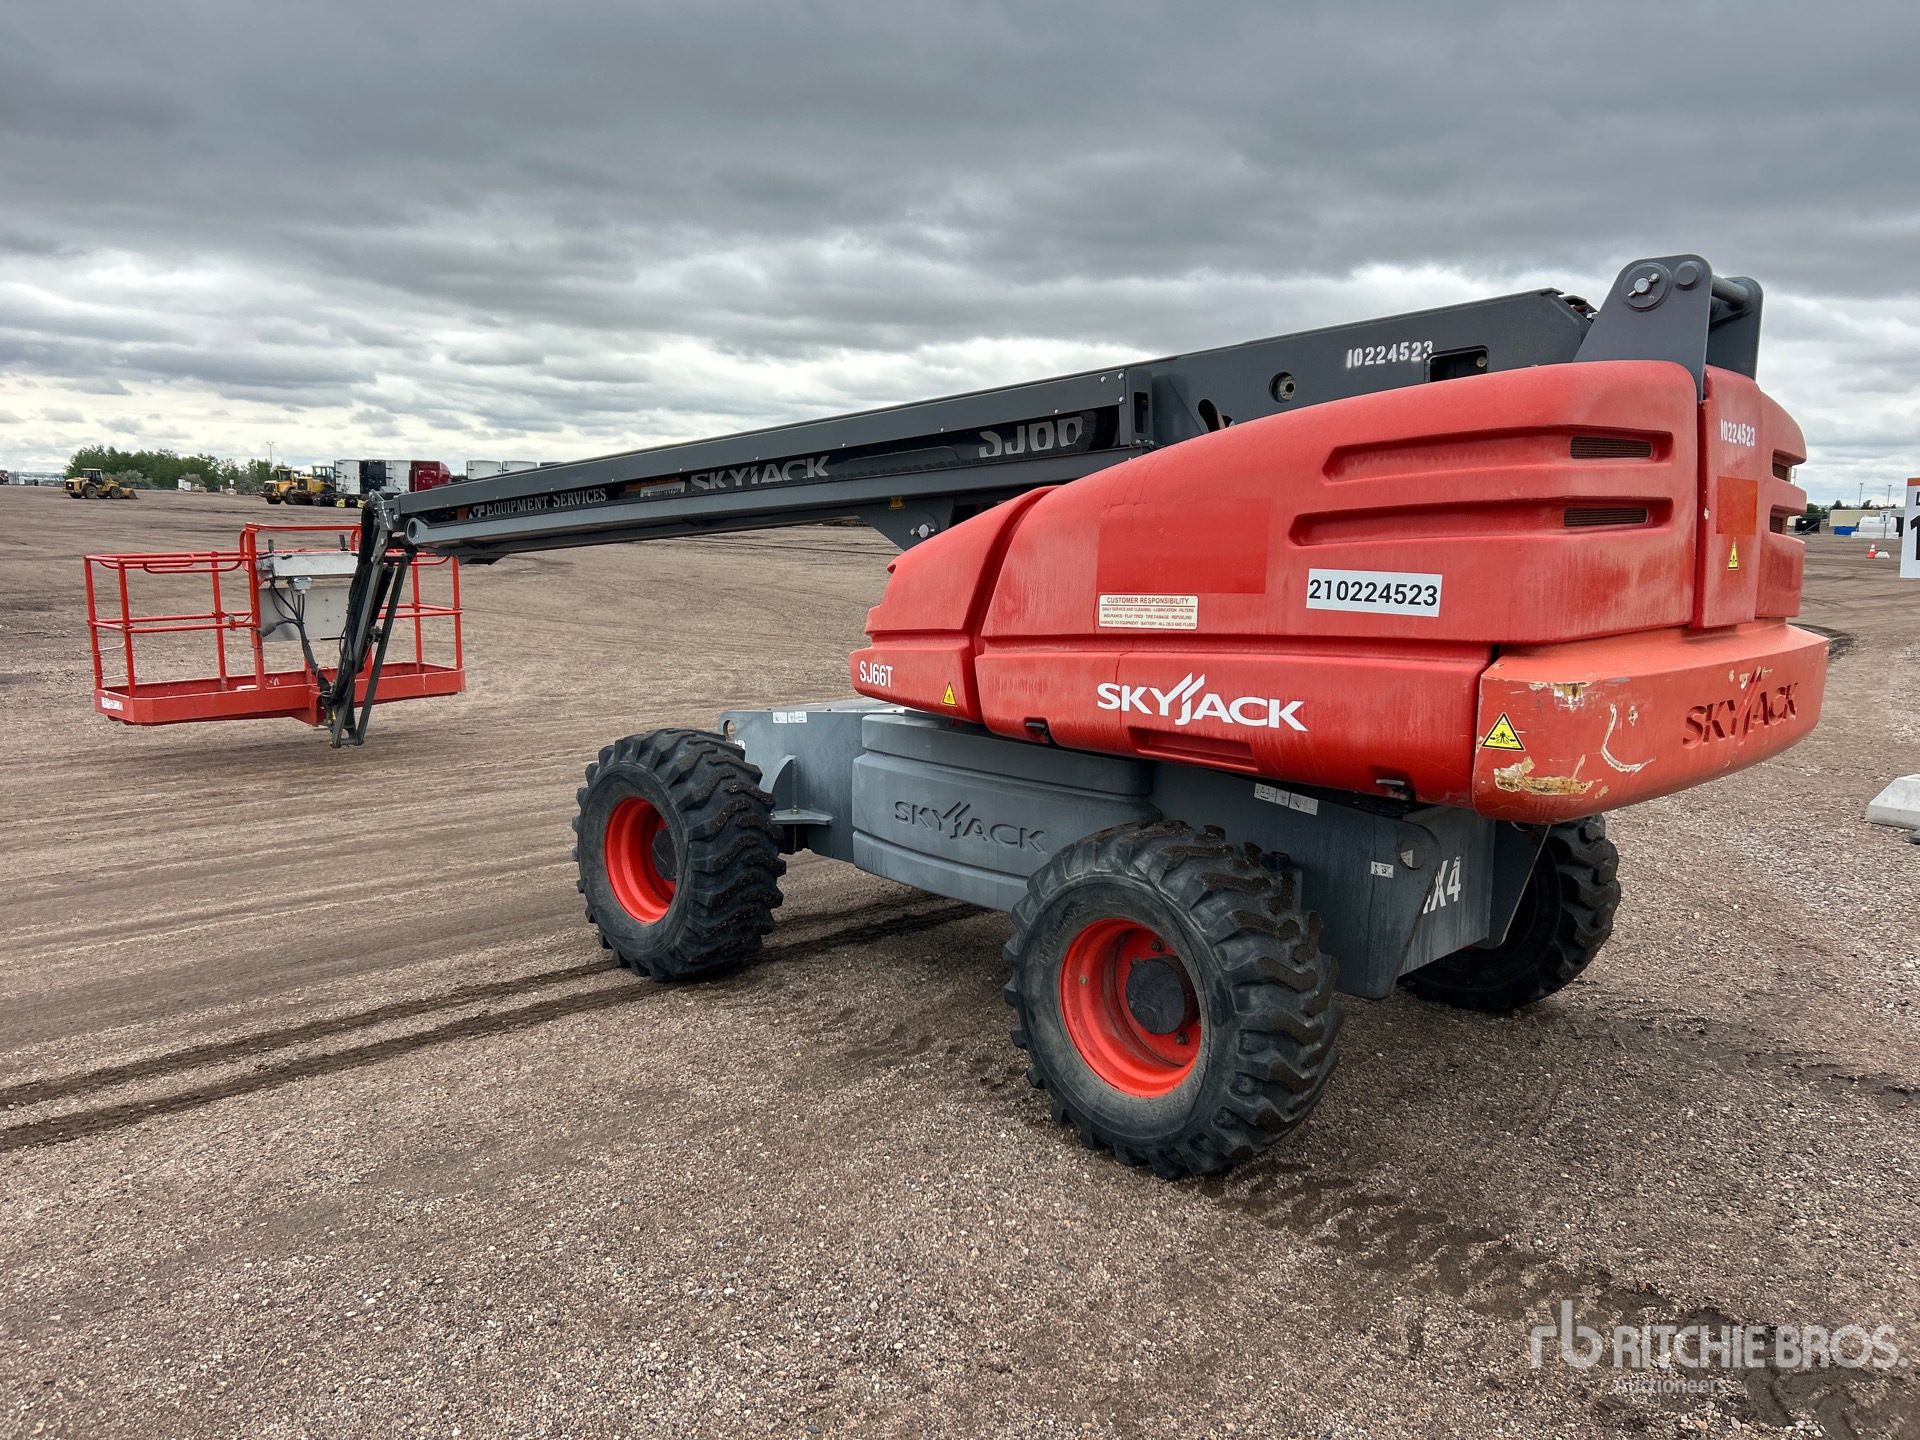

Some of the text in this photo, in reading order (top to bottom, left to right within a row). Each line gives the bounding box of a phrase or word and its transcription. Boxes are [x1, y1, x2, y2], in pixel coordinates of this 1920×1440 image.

[1346, 340, 1433, 369] 10224523
[1720, 419, 1756, 447] 10224523
[486, 496, 549, 516] EQUIPMENT
[553, 488, 607, 508] SERVICES
[1309, 579, 1438, 607] 210224523
[859, 660, 893, 688] SJ66T
[1096, 672, 1309, 732] SKYJACK
[1682, 666, 1798, 749] SKYJACK
[894, 801, 1047, 853] SKYJACK
